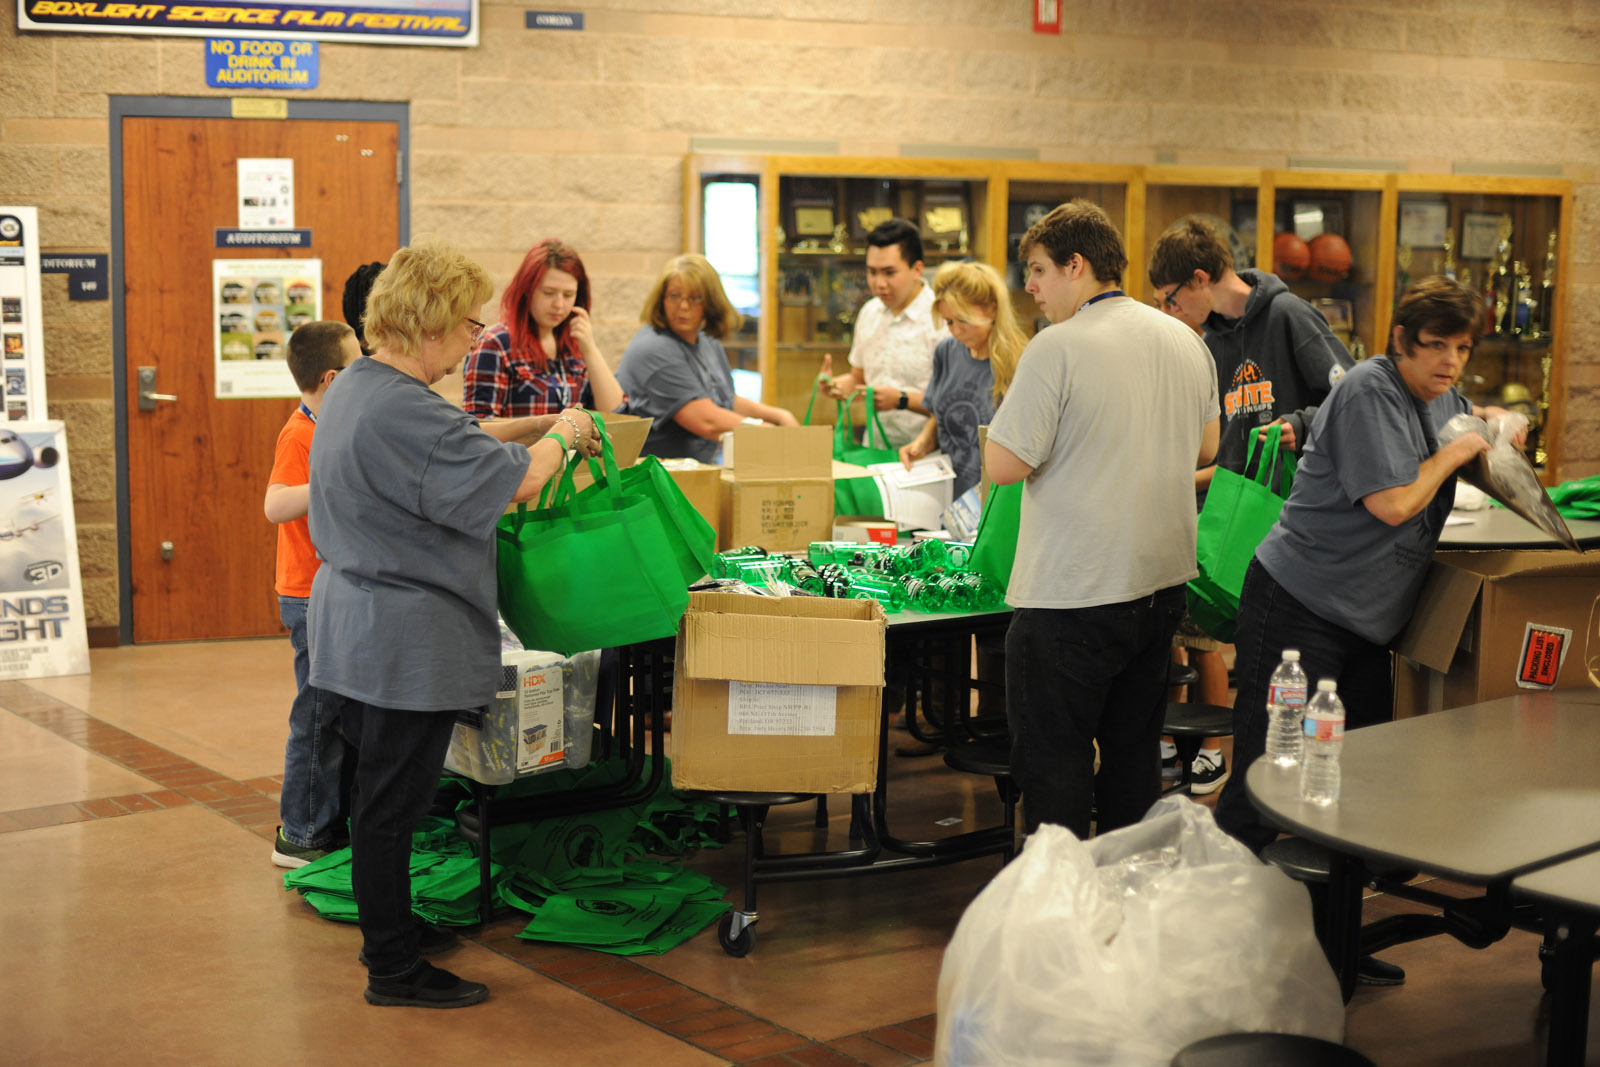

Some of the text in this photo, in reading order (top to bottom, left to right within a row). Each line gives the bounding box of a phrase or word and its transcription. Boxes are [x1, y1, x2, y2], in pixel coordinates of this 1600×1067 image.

[31, 1, 467, 31] BOXLIGHT SCIENCE FILM FESTIVAL
[210, 40, 313, 56] NO FOOD OR
[228, 55, 296, 69] DRINK IN
[217, 68, 309, 84] AUDITORIUM
[226, 232, 301, 245] AUDITORIUM
[42, 258, 97, 269] DITORIUM
[31, 563, 63, 585] 3D
[0, 596, 69, 617] NDS
[1530, 636, 1545, 678] PACKING LIST
[1542, 643, 1555, 676] ENCLOSED
[523, 674, 546, 688] HDX
